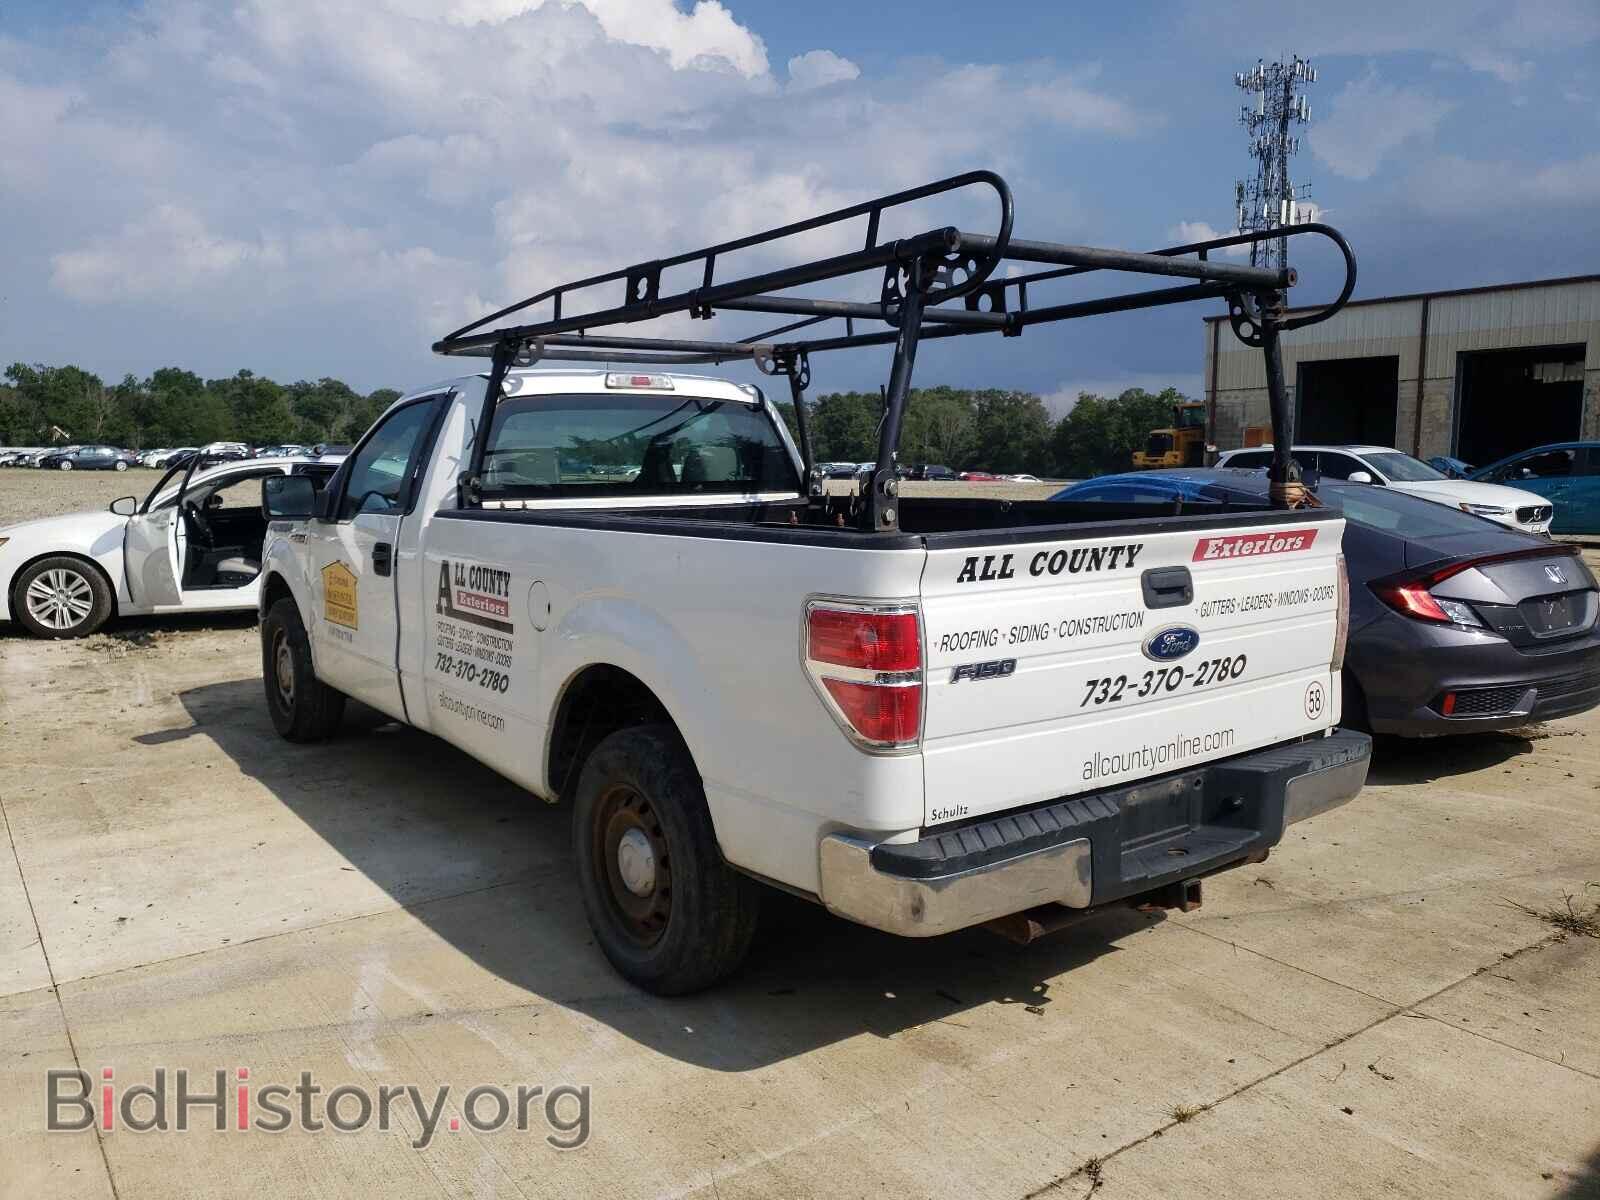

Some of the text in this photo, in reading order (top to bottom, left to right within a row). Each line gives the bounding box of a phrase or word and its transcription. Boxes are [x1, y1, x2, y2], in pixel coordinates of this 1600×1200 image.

[1203, 534, 1305, 559] Exteriors
[957, 544, 1144, 583] ALL COUNTY
[469, 565, 511, 597] COUNTY
[459, 592, 506, 616] Exteriors
[1200, 584, 1335, 617] GUTTERS LEADERS WINDOWS DOORS
[940, 611, 1145, 653] ROOFING SIDING CONSTRUCTION
[435, 652, 510, 694] 732-370-2780
[950, 658, 1017, 684] F-150
[1080, 654, 1247, 708] 732-370-2780
[1308, 688, 1321, 714] 58
[1082, 728, 1234, 780] allcountyonline.com
[931, 804, 968, 821] Schultz
